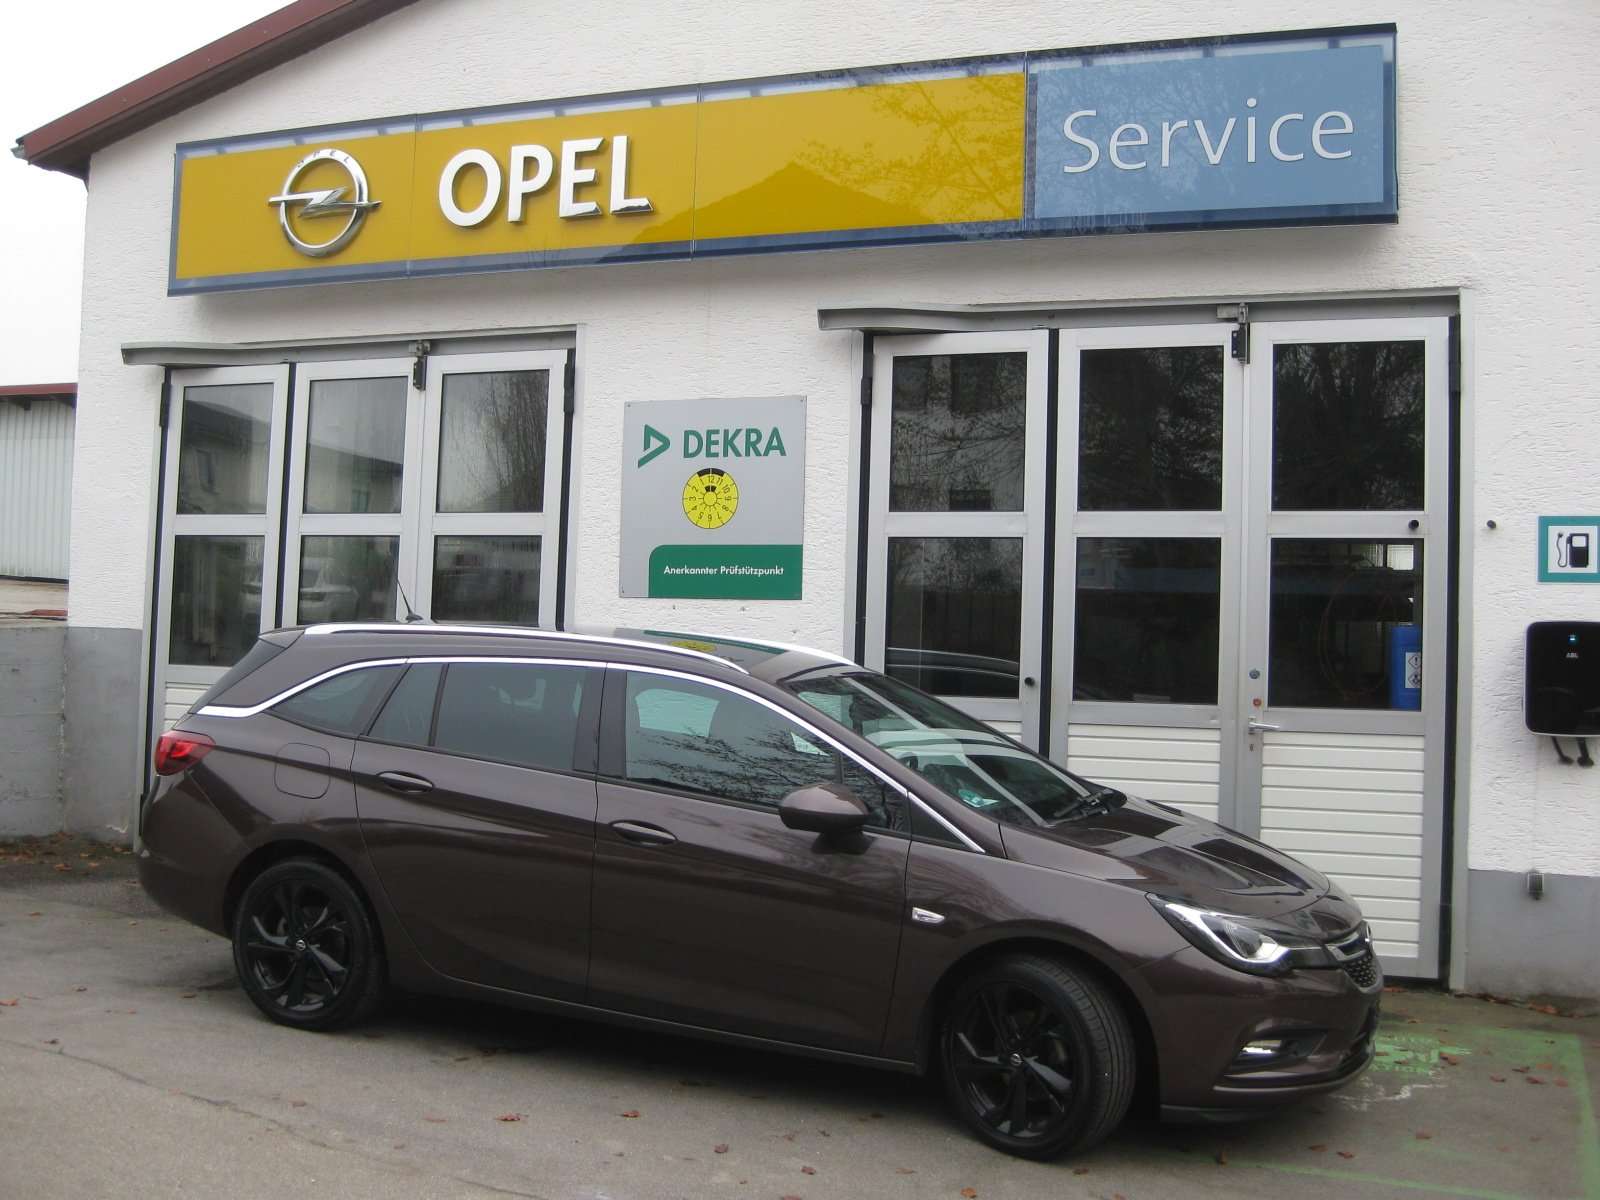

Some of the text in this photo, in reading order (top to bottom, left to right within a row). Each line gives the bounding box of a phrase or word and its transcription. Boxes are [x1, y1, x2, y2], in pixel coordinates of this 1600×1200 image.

[1063, 98, 1355, 173] Service
[439, 134, 654, 227] OPEL
[683, 426, 787, 459] DEKRA
[663, 565, 784, 577] Anerkannter Prüfstützpunkt
